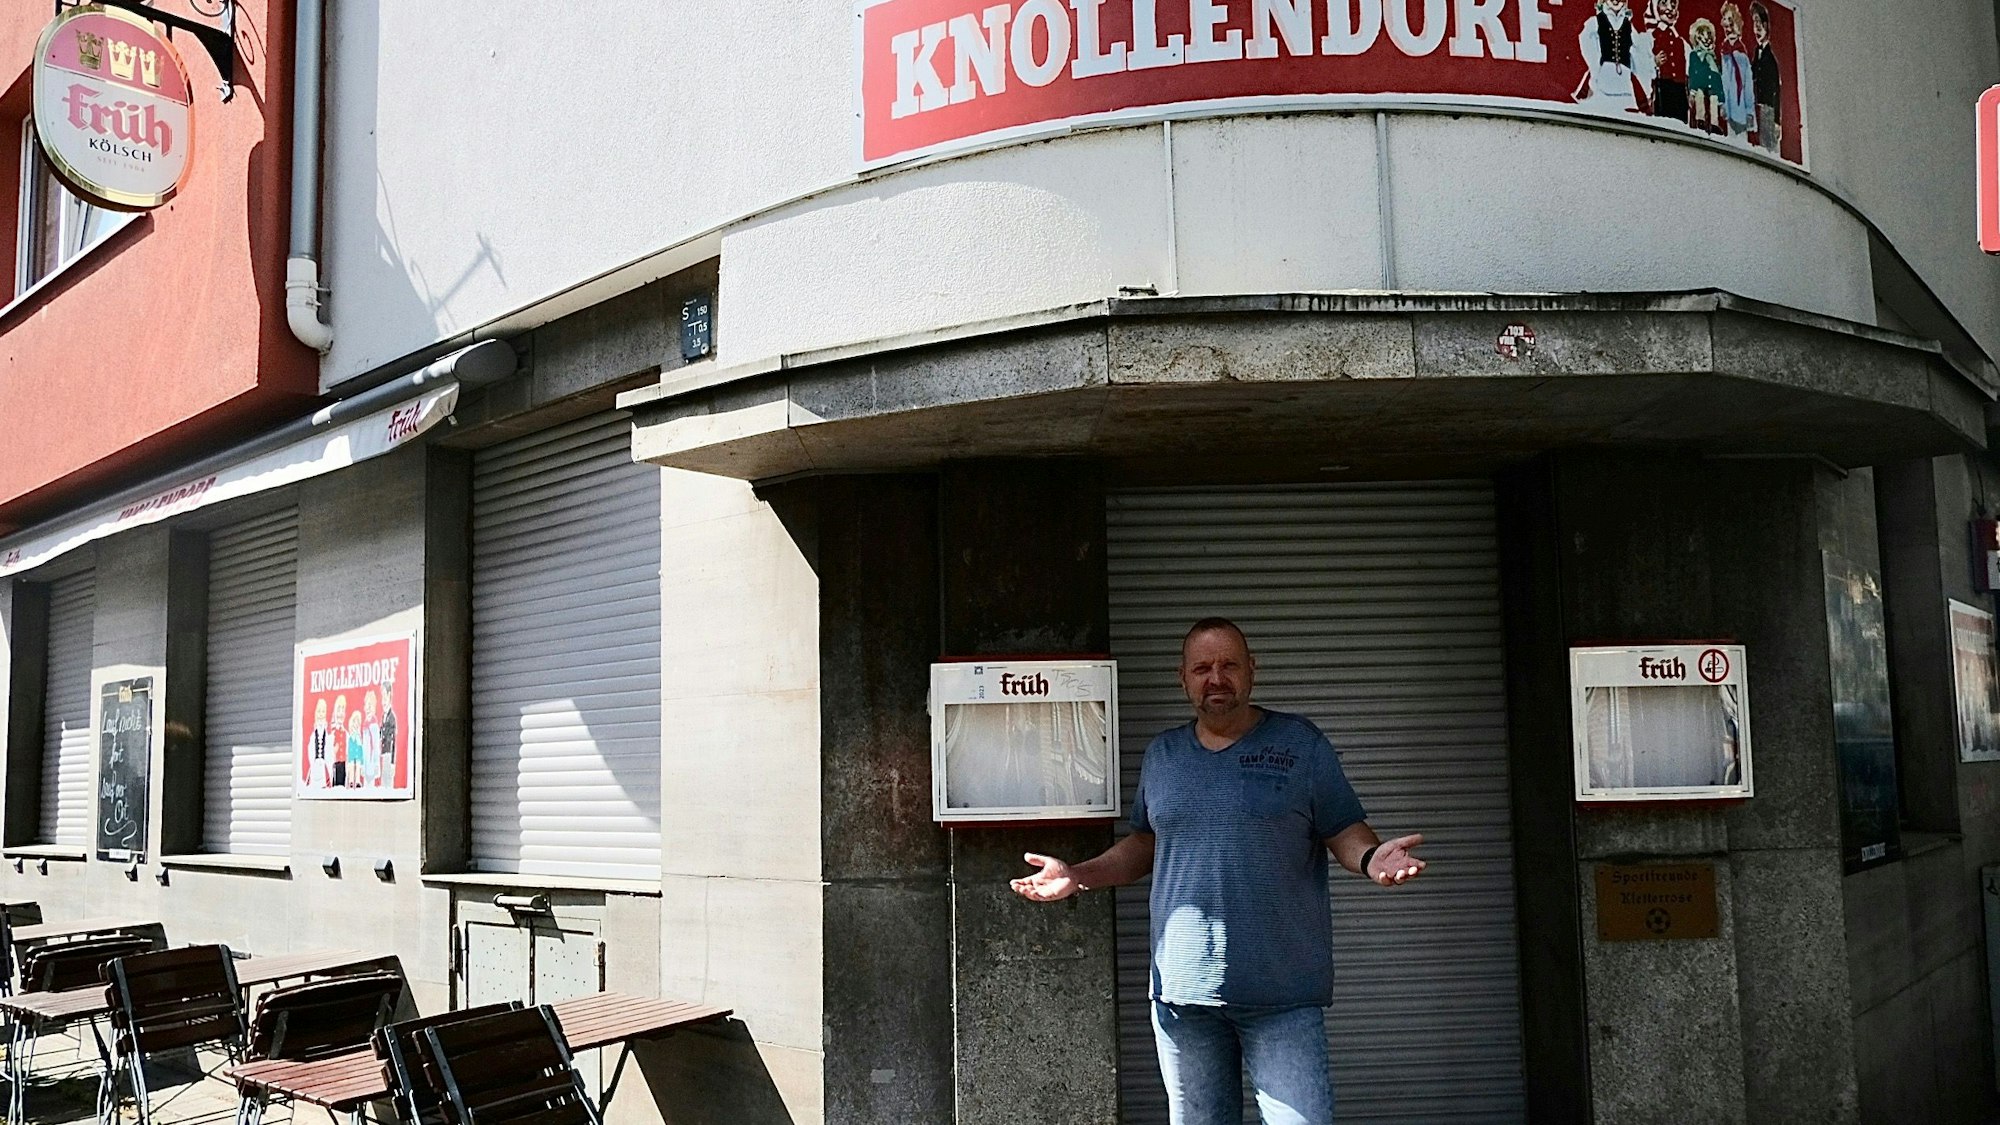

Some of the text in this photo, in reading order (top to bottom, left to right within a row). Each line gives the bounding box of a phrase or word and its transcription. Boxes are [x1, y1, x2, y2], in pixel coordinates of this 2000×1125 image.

[891, 0, 1562, 120] KNOLLENDORF
[88, 137, 152, 163] KÖLSCH
[697, 305, 708, 316] 150
[310, 656, 400, 693] KNOLLENDORF
[1239, 754, 1295, 768] CAMP DAVID
[1611, 869, 1698, 886] Sportfreunde
